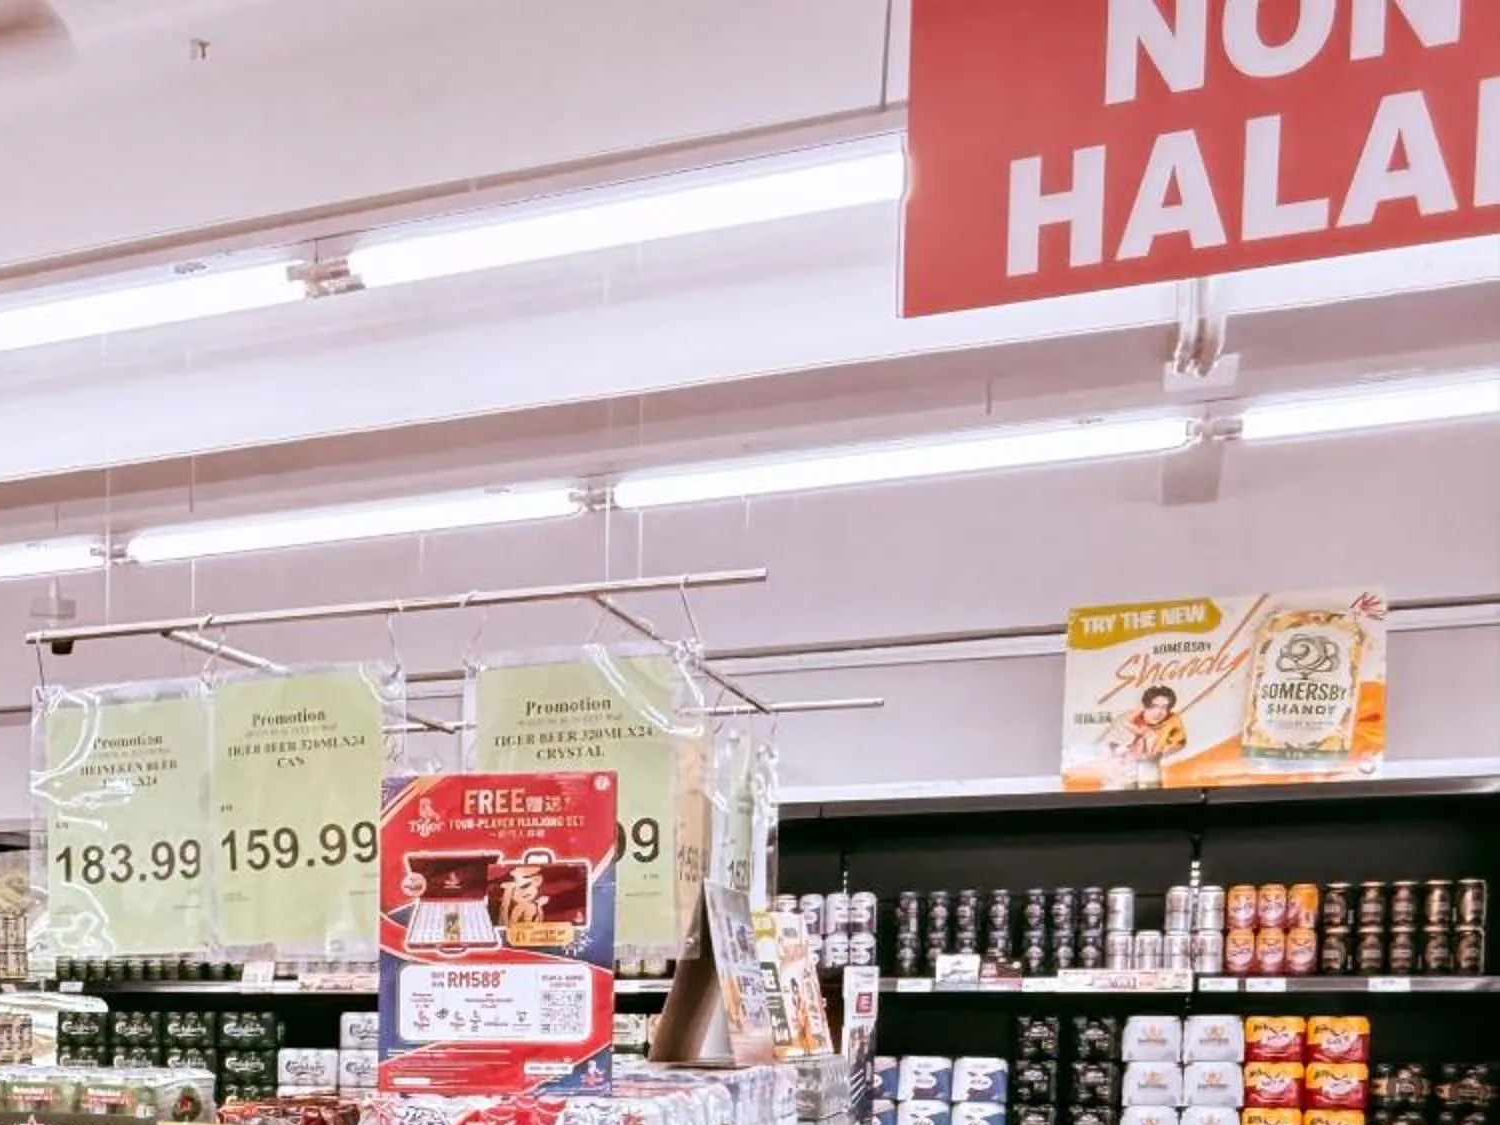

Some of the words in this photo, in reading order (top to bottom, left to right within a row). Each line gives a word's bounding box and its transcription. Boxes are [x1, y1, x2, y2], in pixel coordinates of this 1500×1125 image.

[1105, 0, 1461, 105] NON
[1079, 616, 1114, 634] TRY
[1124, 609, 1157, 629] THE
[1162, 605, 1207, 625] NEW
[1261, 682, 1347, 701] SOMERSBY
[525, 697, 612, 716] Promotion
[1267, 703, 1336, 716] SHANDY
[252, 708, 326, 728] Promotion
[93, 735, 164, 752] Promotion
[536, 745, 605, 761] CRYSTAL
[463, 787, 525, 815] FREE
[221, 820, 379, 872] 159.99
[55, 838, 201, 885] 183.99
